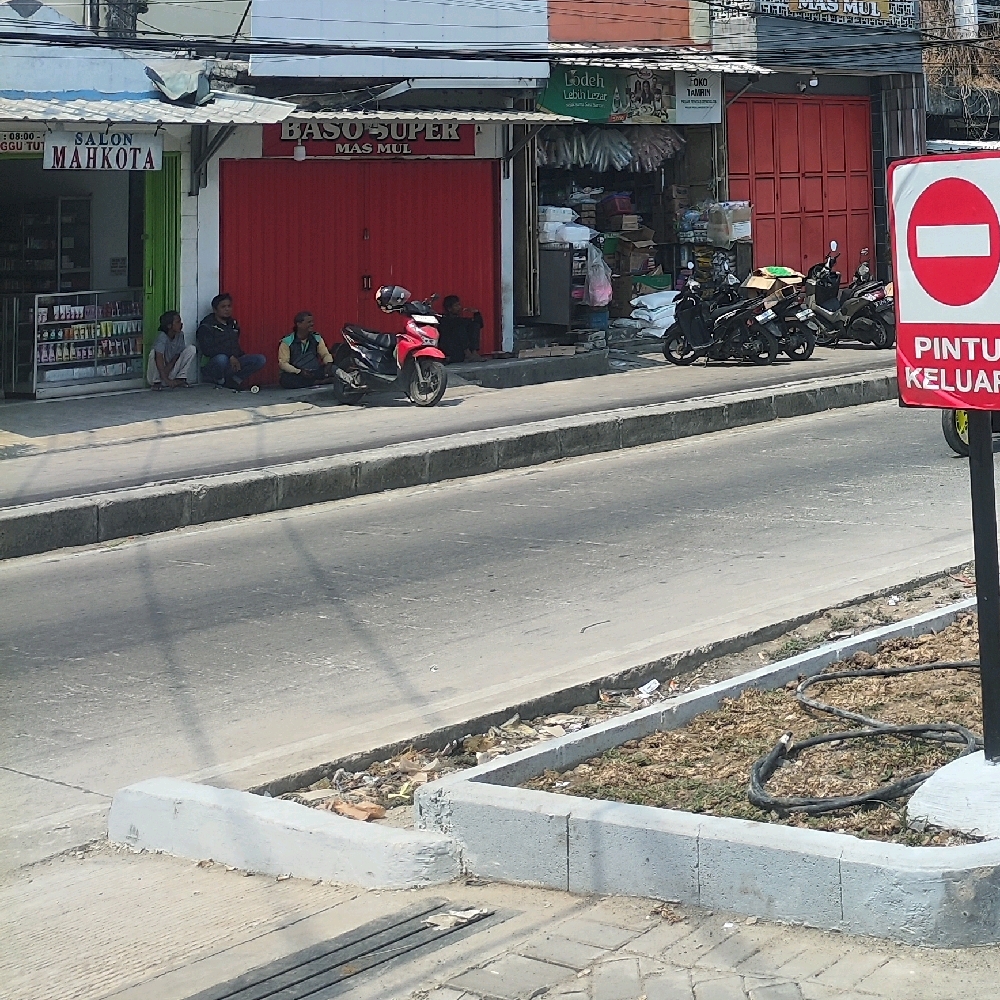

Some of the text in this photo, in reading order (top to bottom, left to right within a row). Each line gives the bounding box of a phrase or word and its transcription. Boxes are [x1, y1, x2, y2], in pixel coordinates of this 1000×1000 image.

[564, 72, 605, 88] Lodeh
[563, 89, 586, 100] Lebih
[9, 132, 35, 140] 08:00
[280, 122, 460, 140] BASO SUPER
[74, 132, 134, 146] SALON
[335, 143, 412, 154] MAS MUL
[51, 146, 155, 169] MAHKOTA
